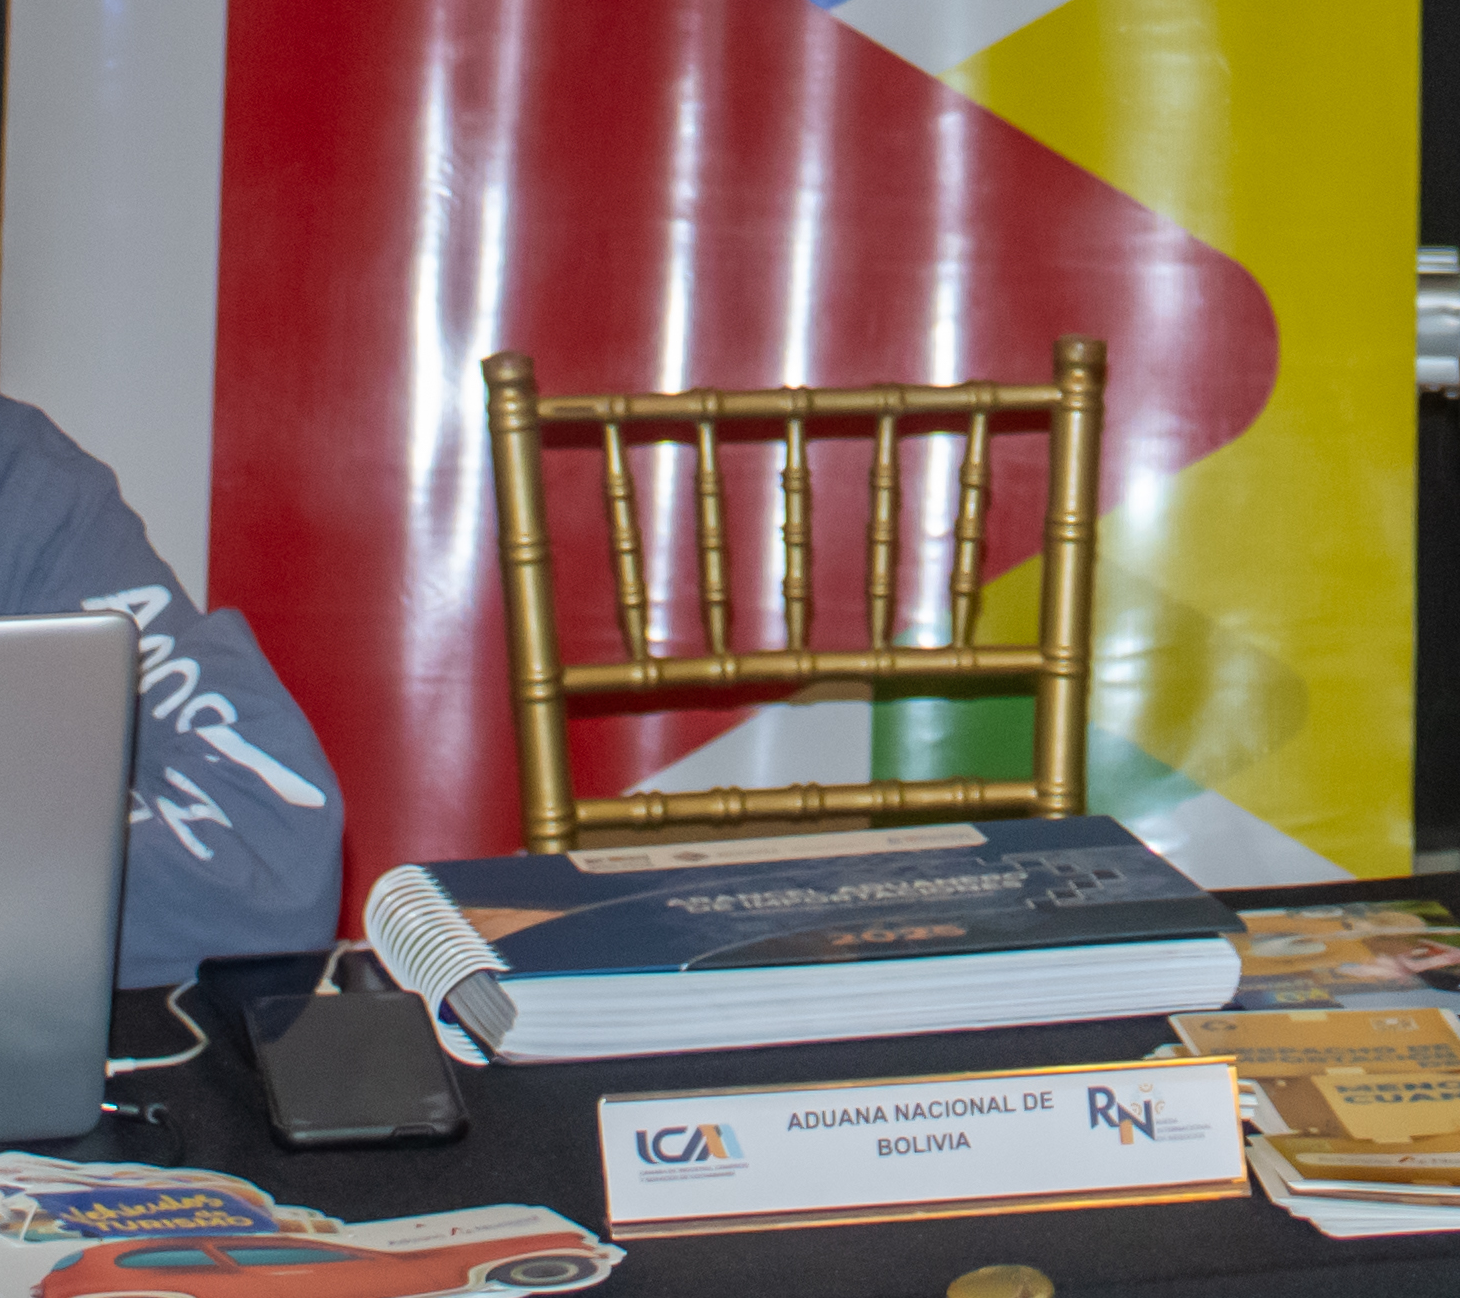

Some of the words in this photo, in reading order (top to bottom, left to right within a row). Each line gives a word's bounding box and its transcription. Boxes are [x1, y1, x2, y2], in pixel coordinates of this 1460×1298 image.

[788, 1106, 888, 1130] ADUANA
[895, 1095, 1017, 1121] NACIONAL
[1022, 1091, 1054, 1111] DE
[878, 1131, 971, 1157] BOLIVIA
